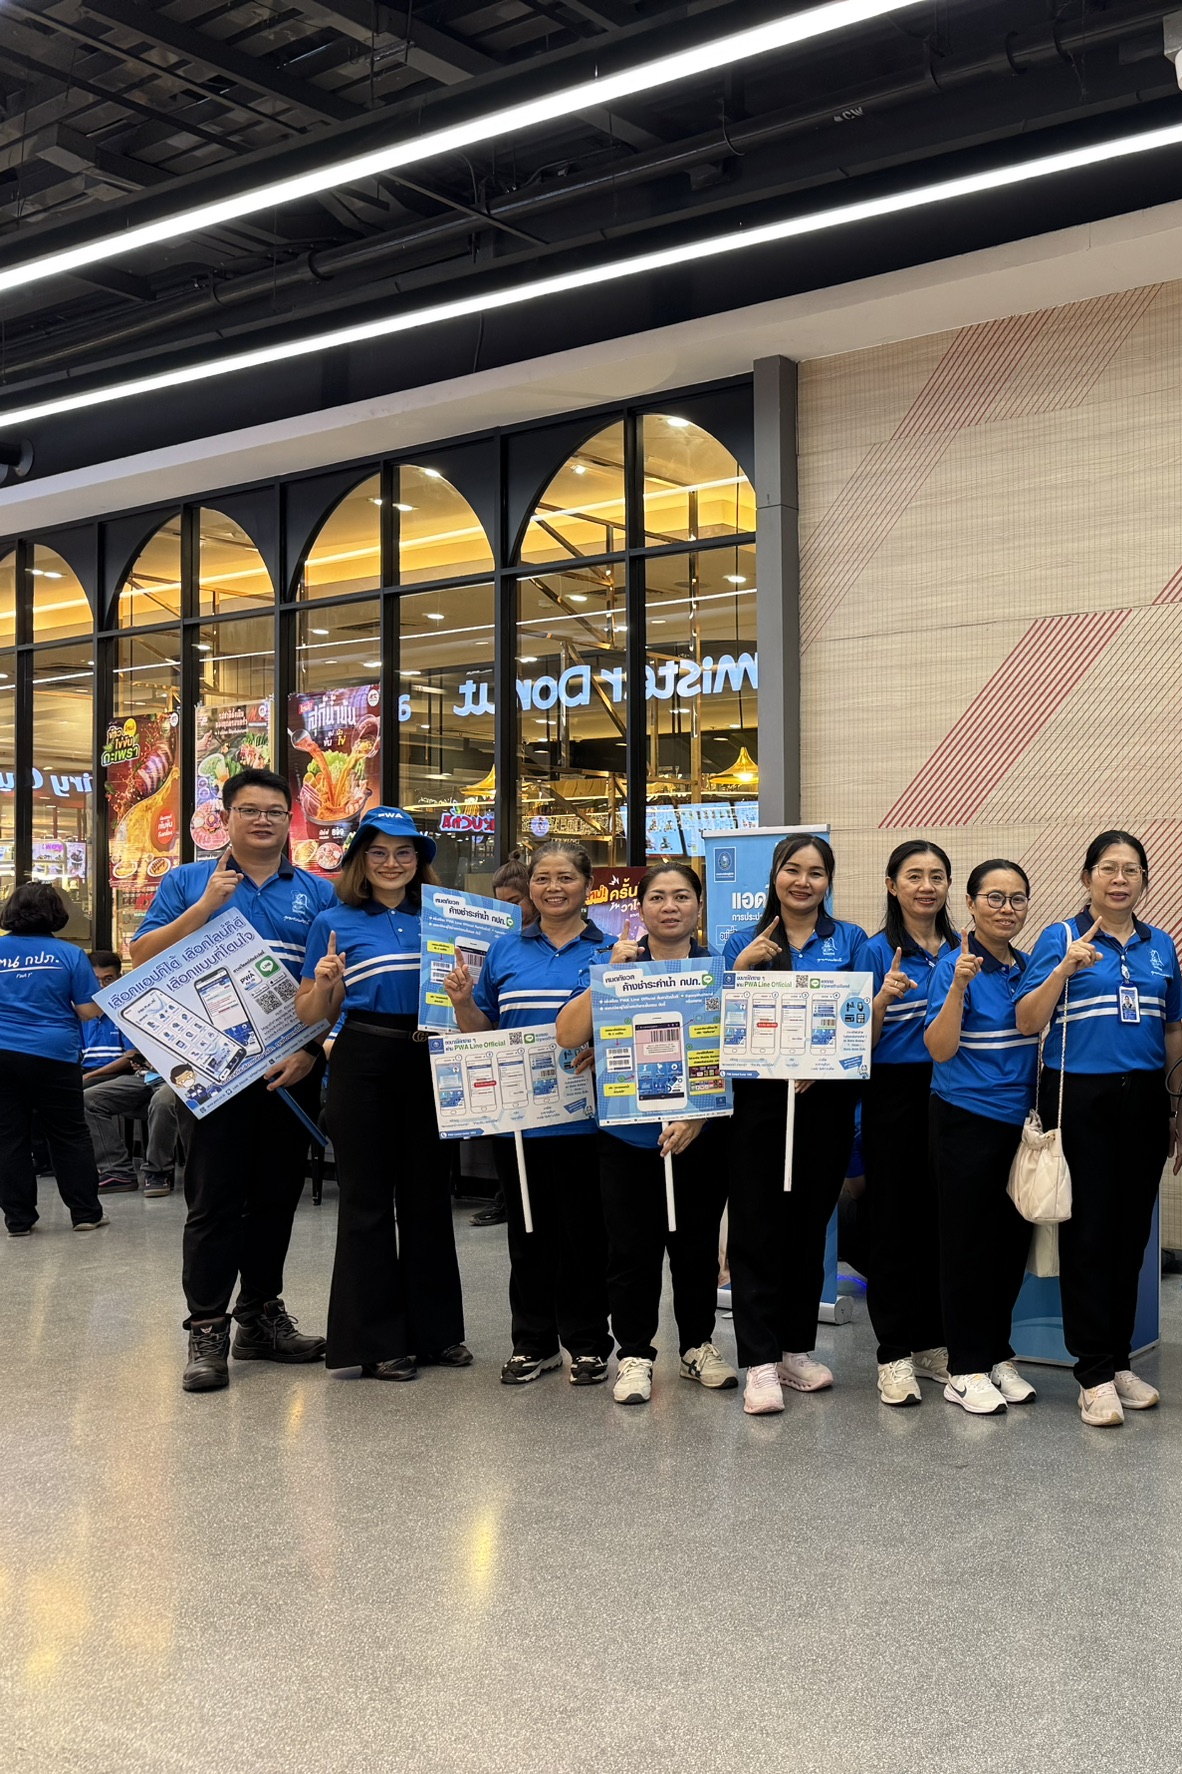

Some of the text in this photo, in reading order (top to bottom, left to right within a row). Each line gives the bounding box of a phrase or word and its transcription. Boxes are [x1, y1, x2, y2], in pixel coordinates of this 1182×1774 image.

[609, 877, 639, 899] ครั้น
[732, 886, 768, 910] แอด
[25, 950, 60, 966] กปภ.
[622, 977, 701, 992] ค้างชำระค่าน้ำ กปภ.
[454, 1043, 469, 1051] PWA
[470, 1042, 483, 1050] Line
[484, 1040, 506, 1049] Official
